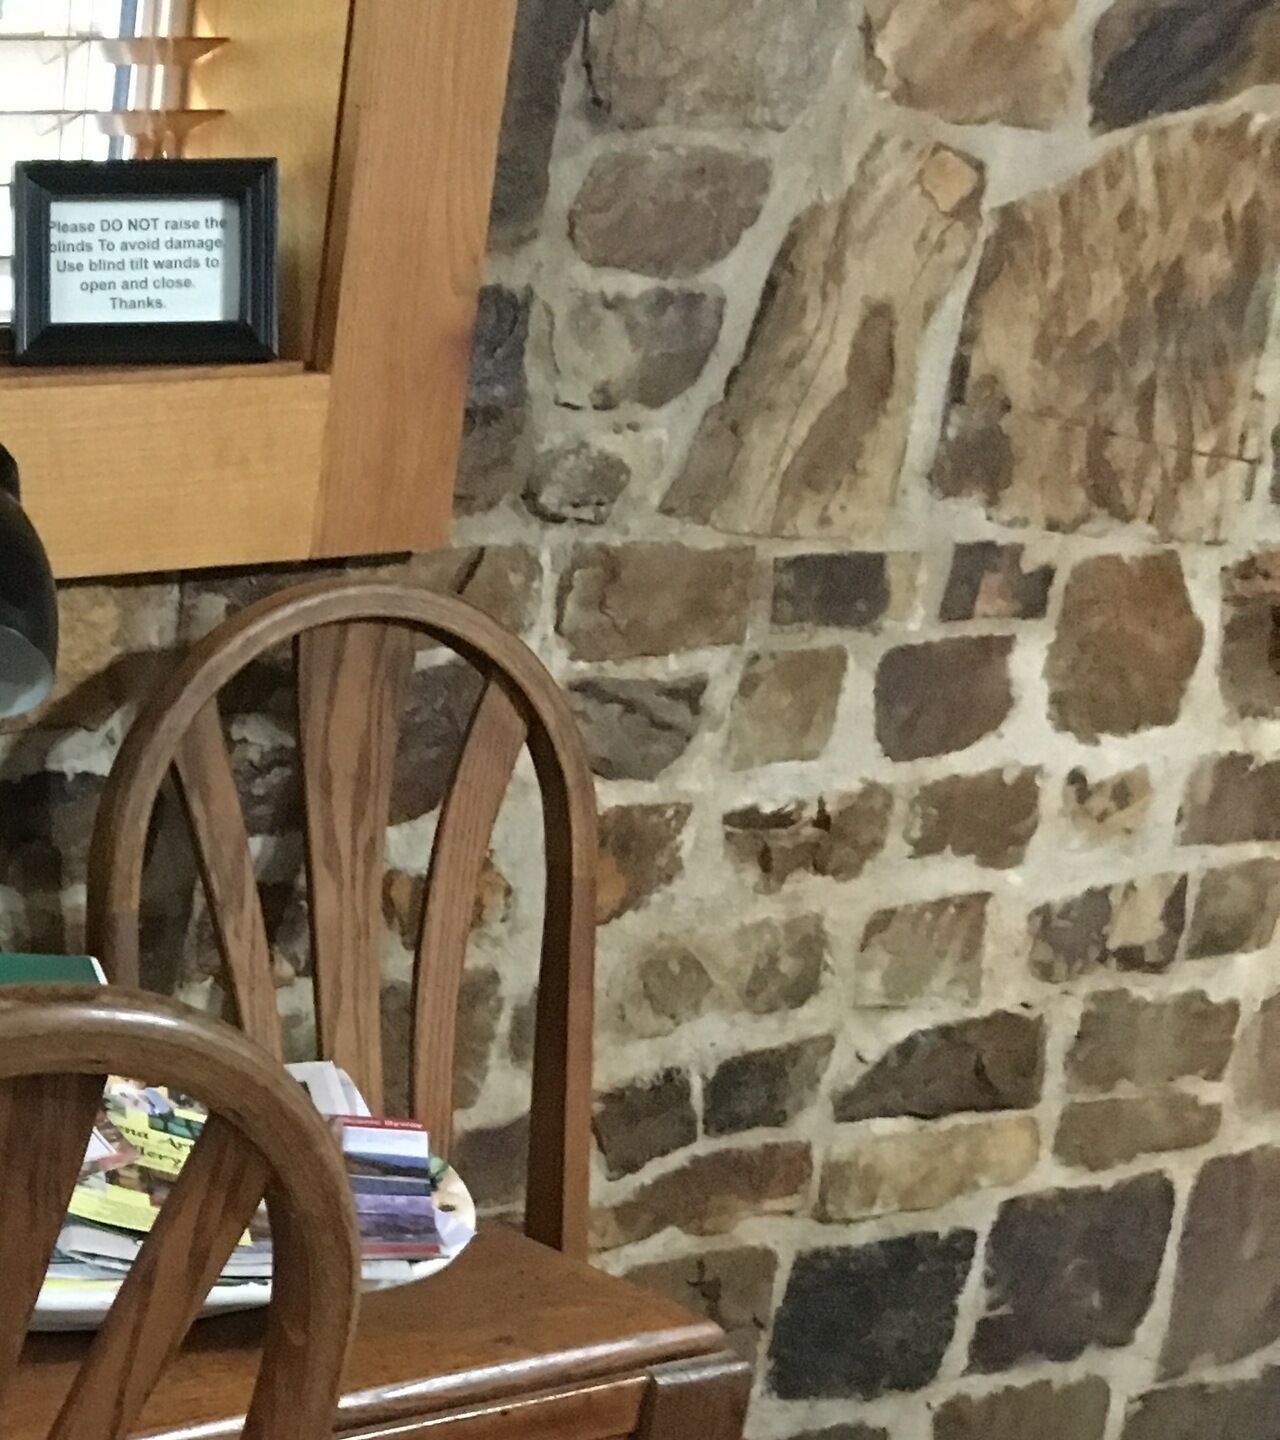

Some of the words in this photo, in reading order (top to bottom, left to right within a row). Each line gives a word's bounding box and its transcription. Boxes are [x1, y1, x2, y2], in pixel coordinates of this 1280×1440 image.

[48, 220, 96, 234] Please
[100, 218, 124, 233] DO
[127, 217, 160, 232] NOT
[164, 218, 201, 231] raise
[204, 215, 228, 230] the
[98, 238, 116, 252] To
[120, 237, 160, 251] avoid
[56, 259, 85, 273] Use
[89, 258, 126, 272] blind
[130, 257, 150, 271] tilt
[153, 256, 201, 270] wands
[205, 256, 220, 269] to
[79, 279, 117, 294] open
[121, 277, 149, 291] and
[152, 276, 196, 290] close.
[109, 297, 167, 311] Thanks.
